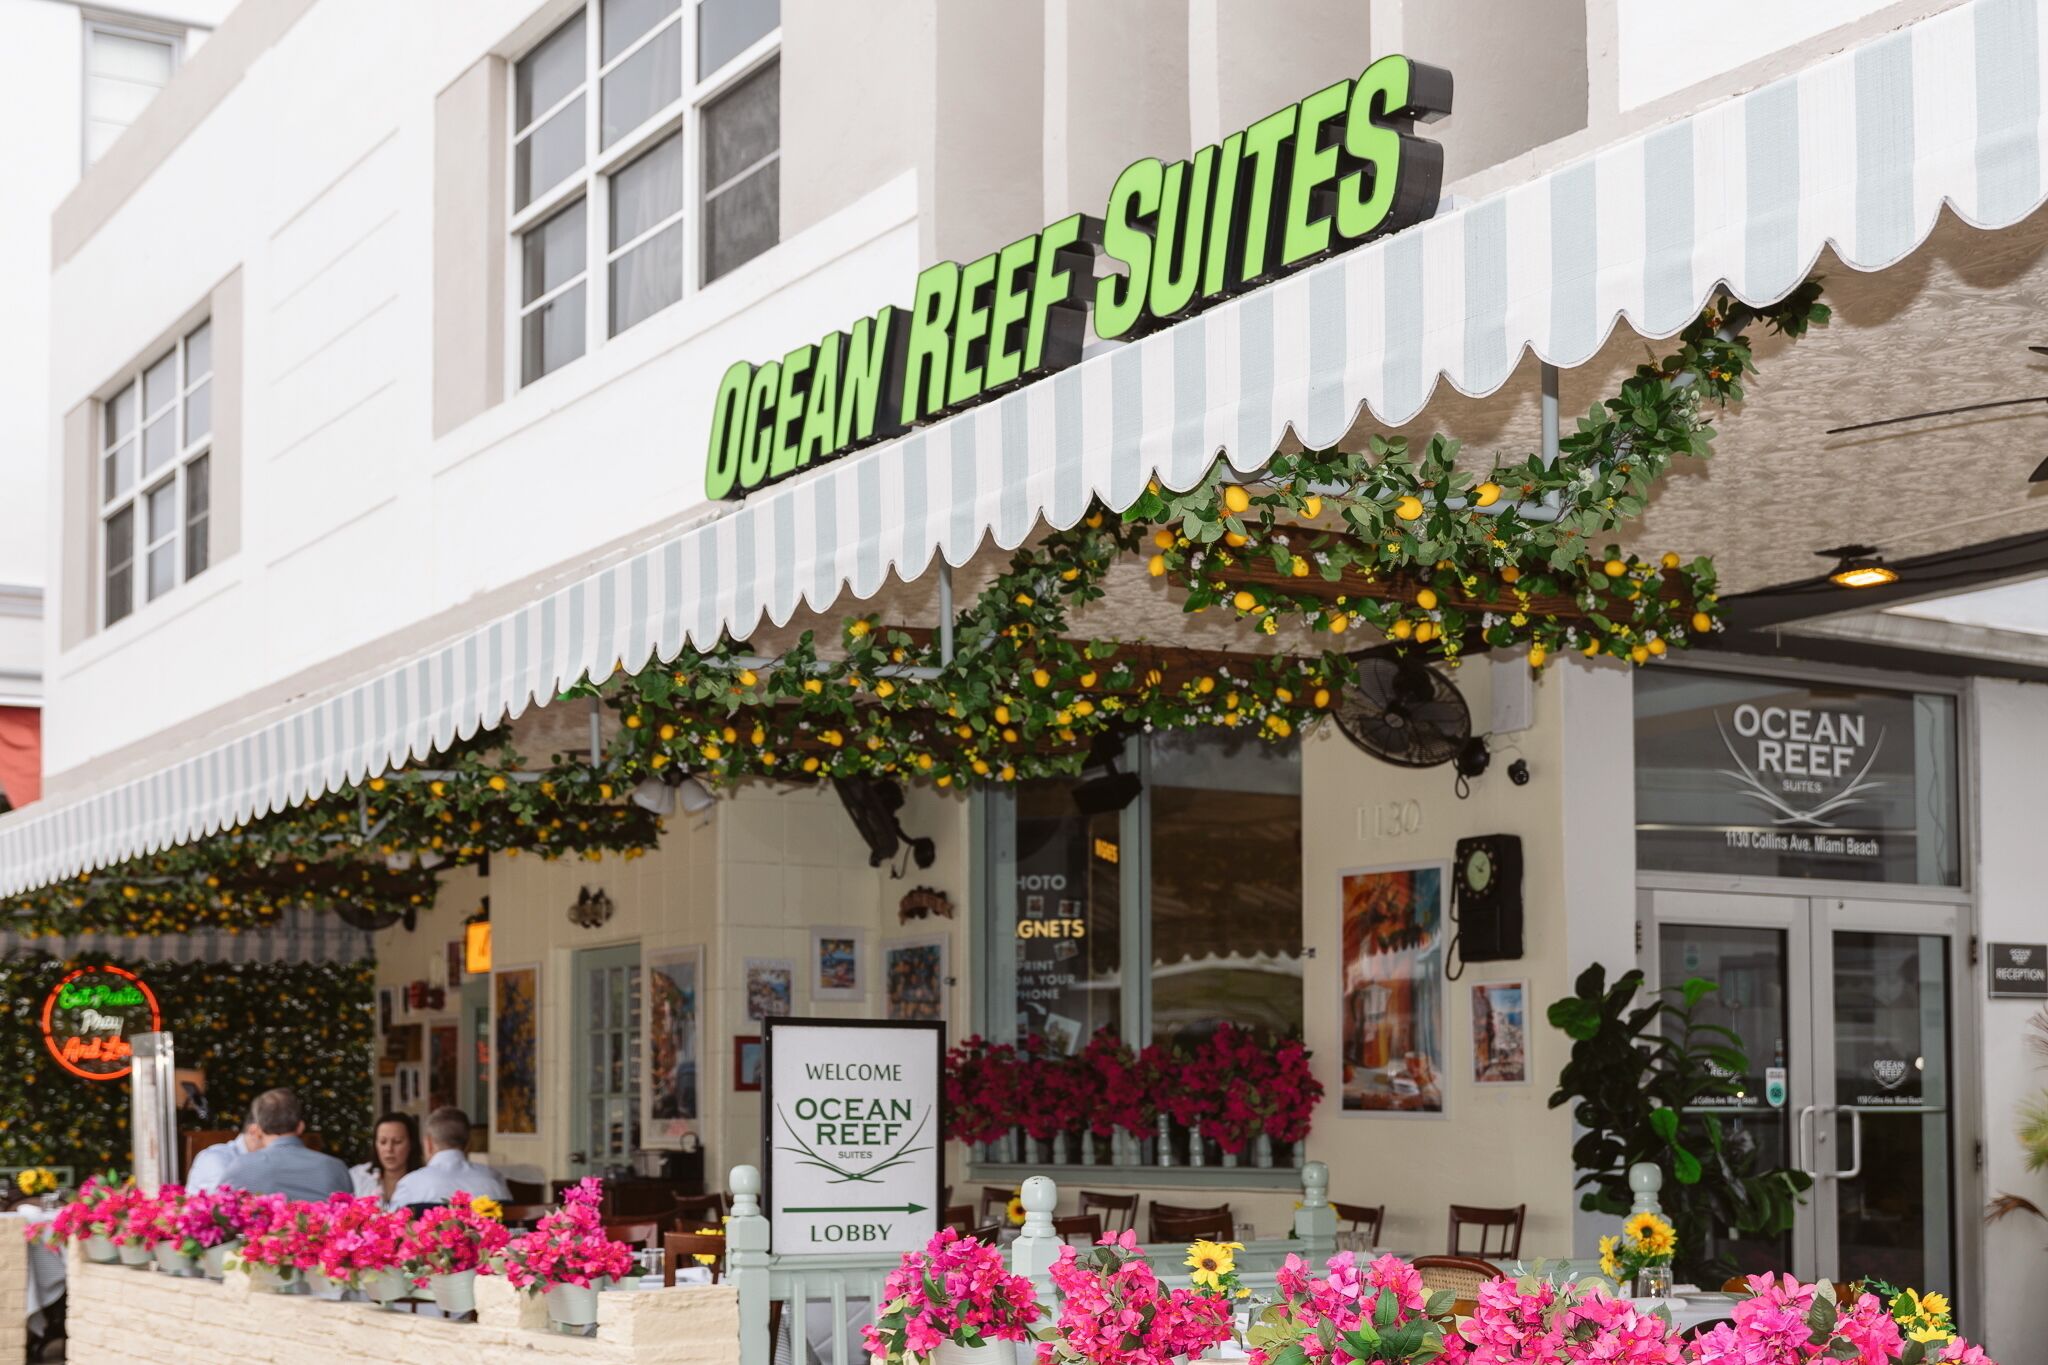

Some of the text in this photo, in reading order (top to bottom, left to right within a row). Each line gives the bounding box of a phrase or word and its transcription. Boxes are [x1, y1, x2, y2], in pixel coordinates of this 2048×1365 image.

[704, 53, 1418, 501] OCEAN REEF SUITES
[1733, 704, 1866, 747] OCEAN
[1757, 739, 1855, 778] REEF
[1782, 779, 1823, 794] SUITES
[1357, 798, 1422, 841] 1130
[1725, 831, 1880, 856] 1130 Collins Ave. Miami Beach
[1016, 875, 1067, 891] HOTO
[1014, 919, 1086, 938] GNETS
[1995, 967, 2045, 981] RECEPTION
[81, 1009, 124, 1036] Pray
[805, 1062, 903, 1082] WELCOME
[794, 1097, 913, 1121] OCEAN
[816, 1123, 902, 1146] REEF
[838, 1150, 873, 1160] SUITES
[810, 1223, 893, 1243] LOBBY
